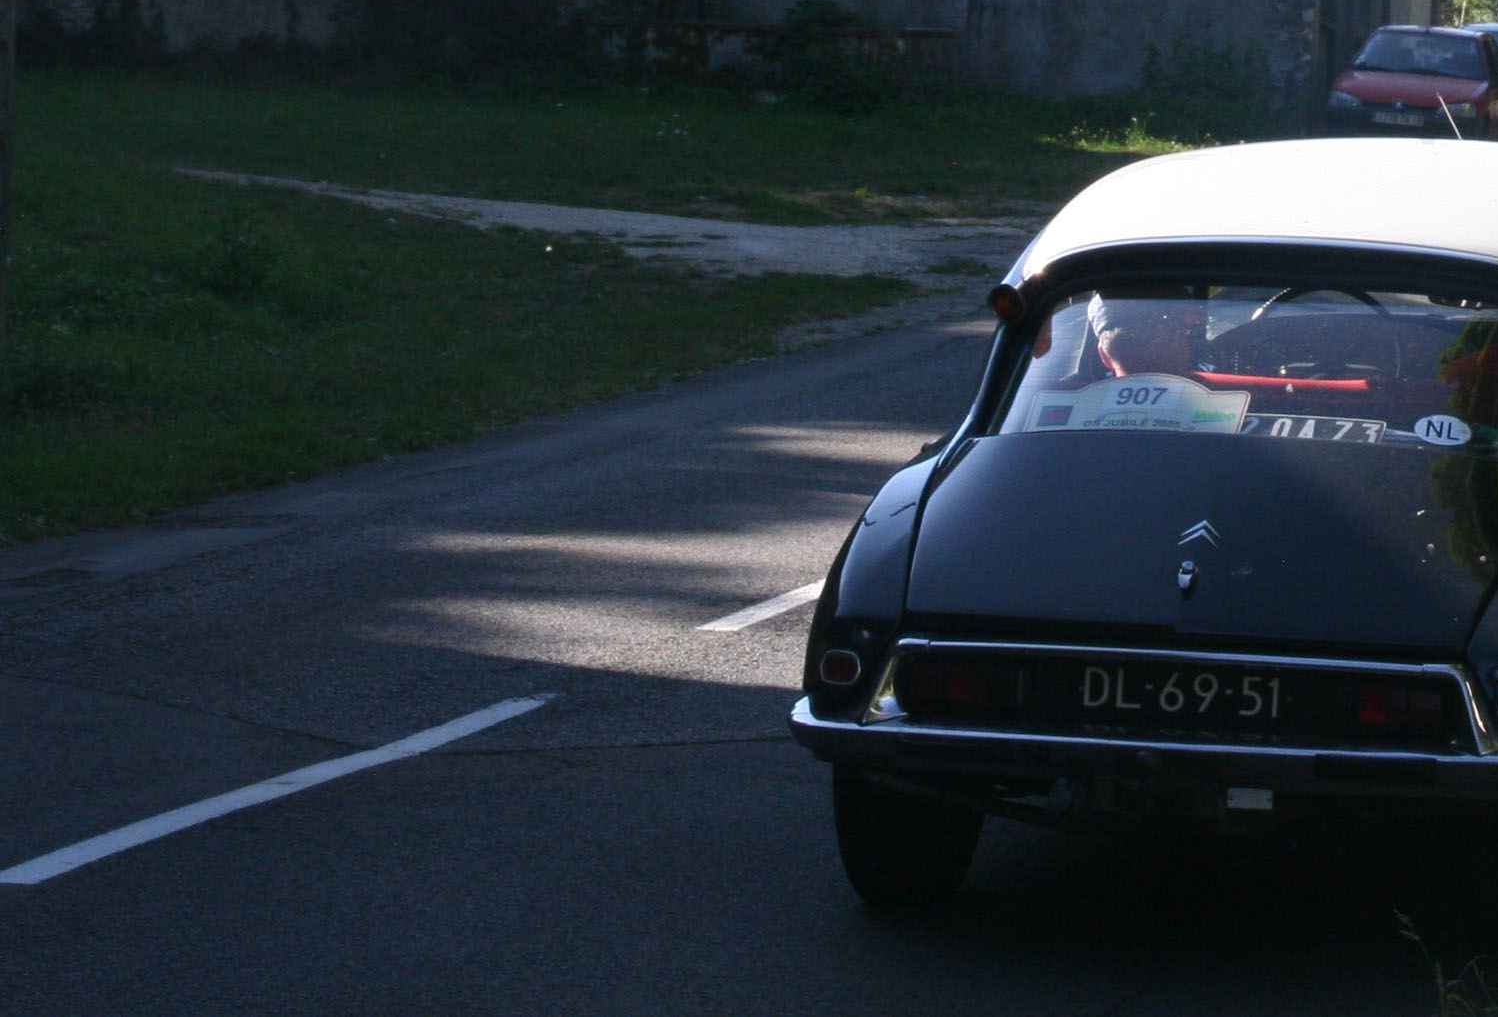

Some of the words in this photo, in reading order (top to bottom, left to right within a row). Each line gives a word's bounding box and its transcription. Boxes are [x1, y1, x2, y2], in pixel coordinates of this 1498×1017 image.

[1116, 387, 1168, 405] 907
[1425, 419, 1460, 441] NL
[1083, 666, 1280, 718] DL-69-51
